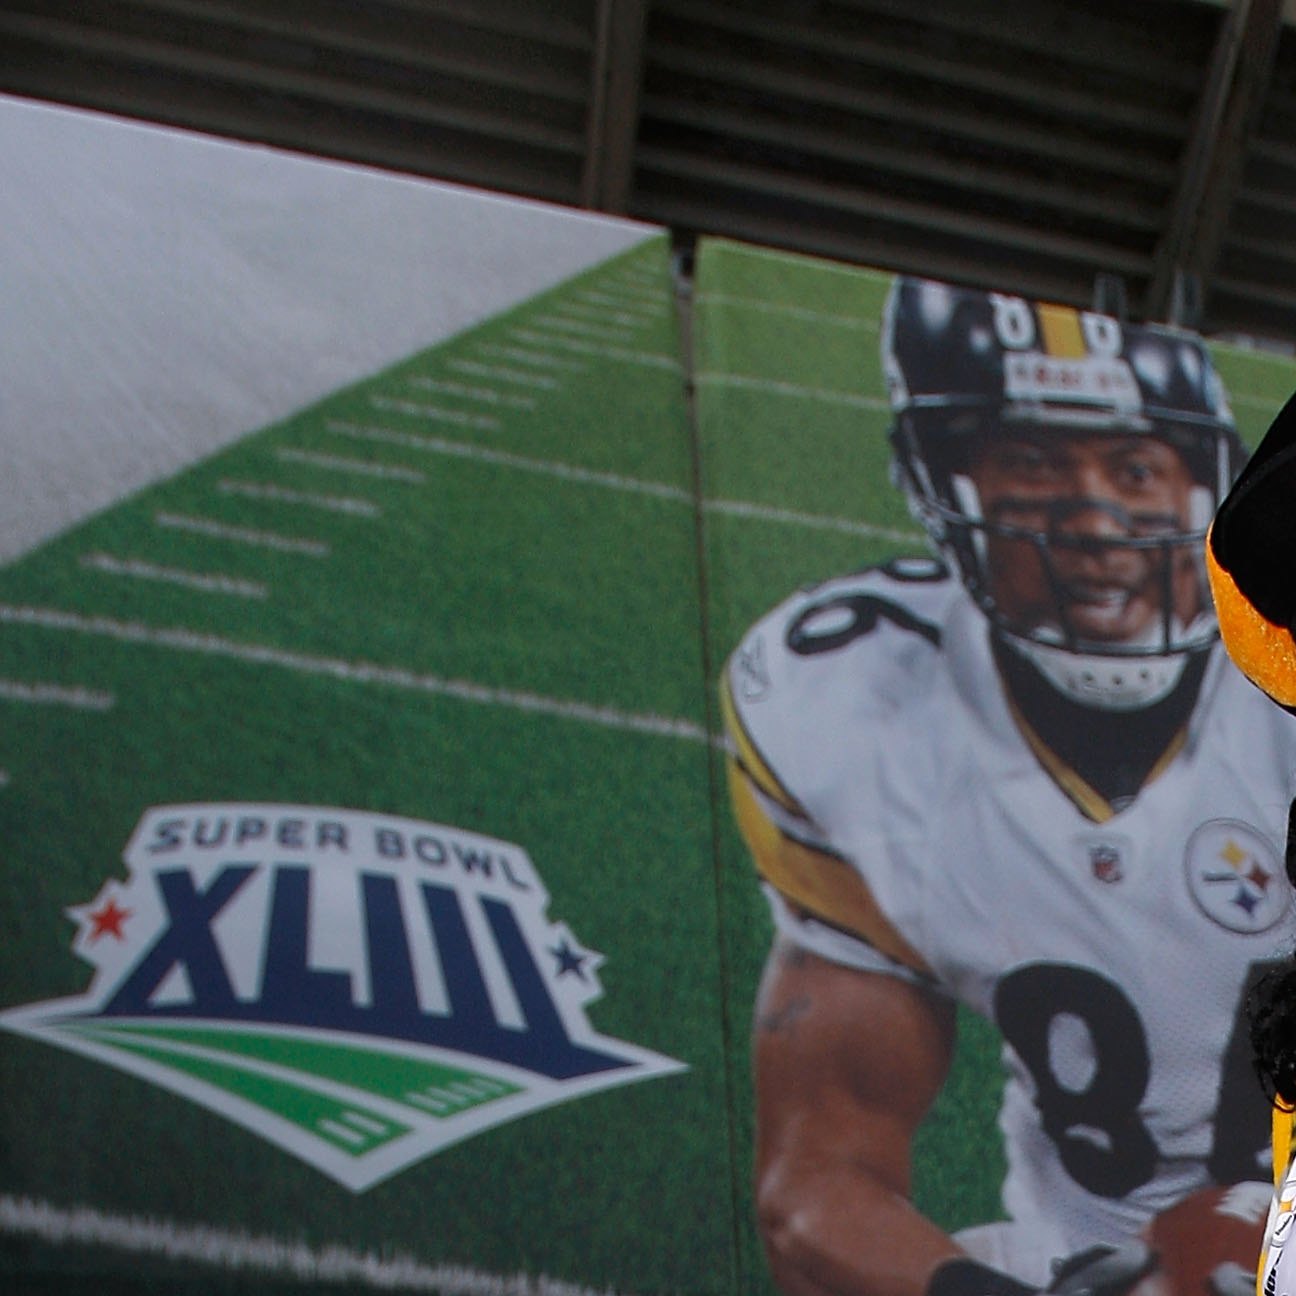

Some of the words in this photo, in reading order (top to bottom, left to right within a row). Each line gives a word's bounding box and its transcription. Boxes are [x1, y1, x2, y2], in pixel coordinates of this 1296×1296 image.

[147, 816, 350, 855] SUPER
[374, 826, 533, 893] BOWL
[103, 861, 572, 1040] XLIII
